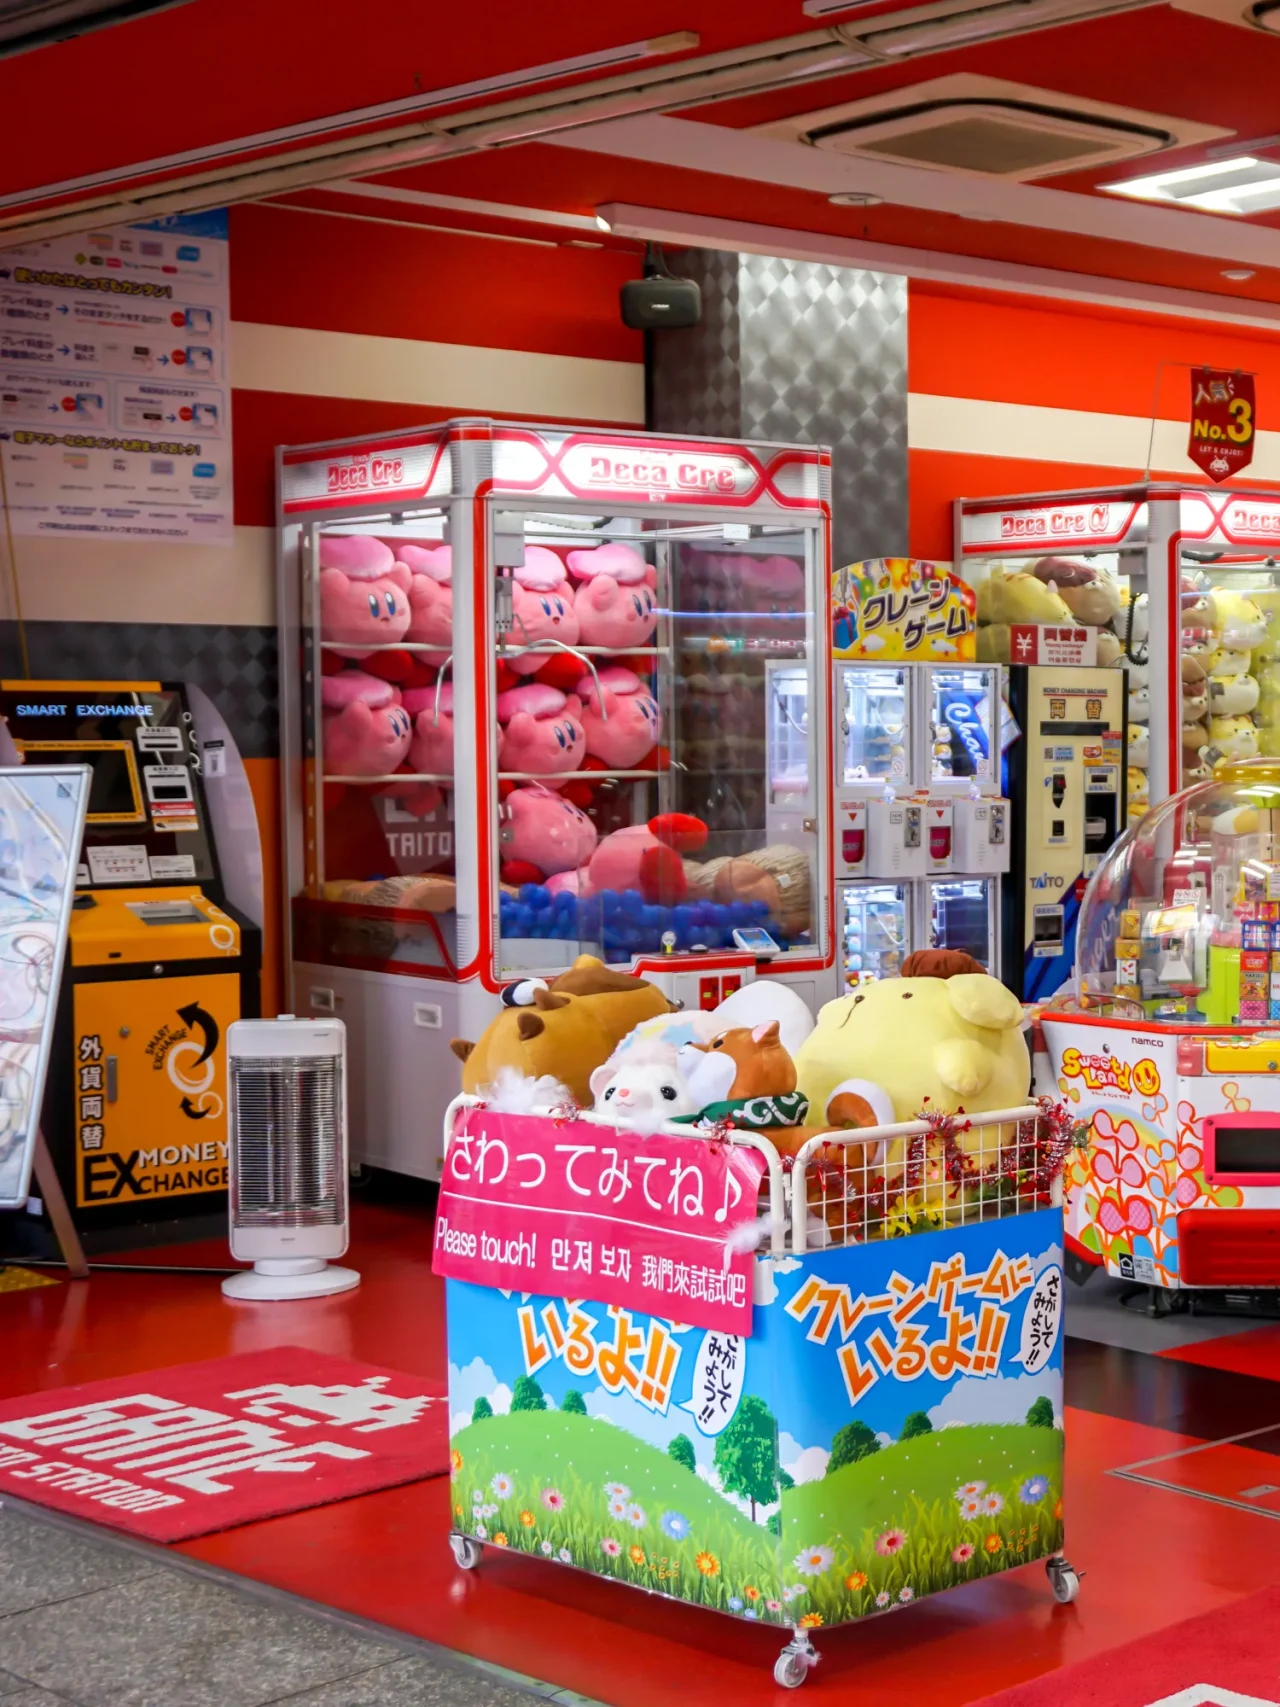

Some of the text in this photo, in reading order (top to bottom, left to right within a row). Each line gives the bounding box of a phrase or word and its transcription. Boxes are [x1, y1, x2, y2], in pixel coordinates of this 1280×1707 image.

[327, 457, 404, 492] Deca Cre
[589, 456, 736, 492] Deca Cre
[864, 576, 951, 630] クレーン
[903, 605, 968, 652] ゲーム
[16, 705, 153, 716] SMART EXCHANGE
[1131, 1036, 1164, 1048] namco
[80, 1035, 105, 1150] 外貨両替
[451, 1129, 705, 1218] さわってみてね
[436, 1216, 537, 1269] Please touch!
[552, 1237, 632, 1284] 만져 보자
[641, 1253, 746, 1310] 我們來試試吧
[785, 1249, 1035, 1346] クレーンゲームに
[9, 1461, 185, 1514] STATION
